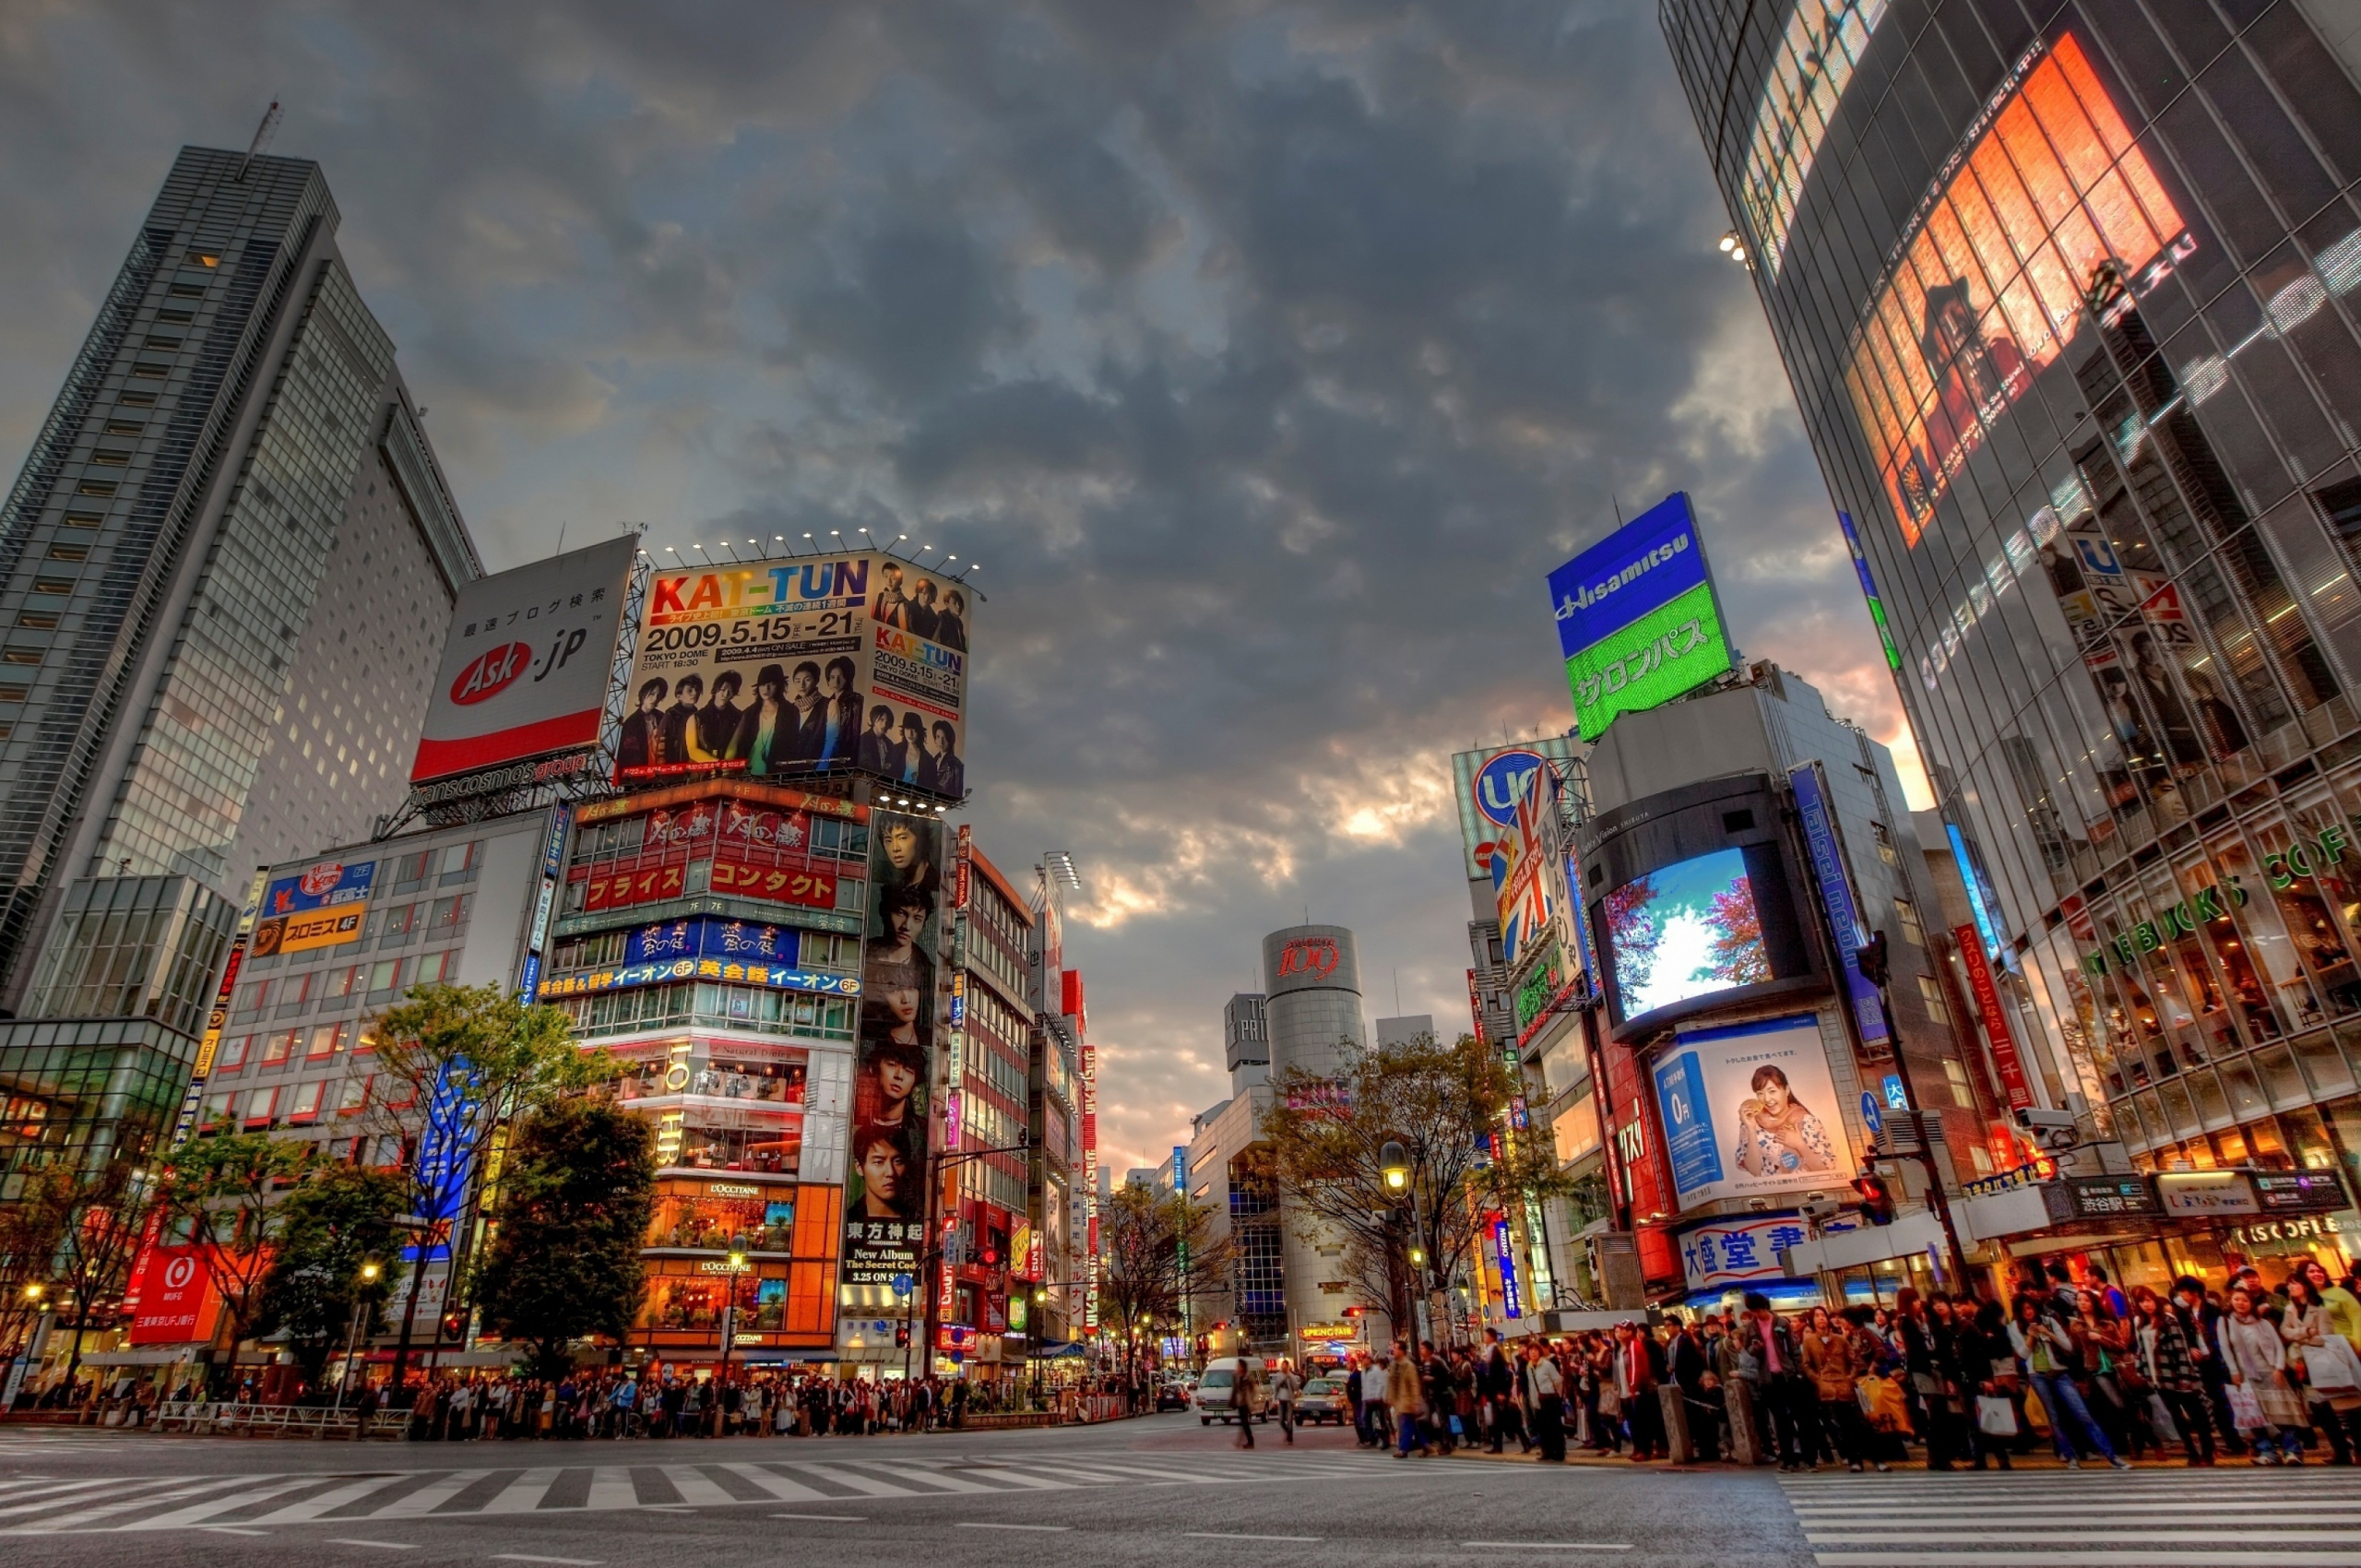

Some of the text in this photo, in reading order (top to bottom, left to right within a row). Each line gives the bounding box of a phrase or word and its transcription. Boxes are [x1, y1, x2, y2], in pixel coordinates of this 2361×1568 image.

[652, 559, 869, 614] KAT-TUN
[1554, 532, 1690, 621] Hisamitsu
[463, 588, 606, 637] 最速ブログ検索
[644, 616, 791, 653] 2009.5.15
[643, 649, 708, 662] TOKYO DOME
[875, 626, 962, 672] KAT-TUN
[641, 659, 698, 671] START 18:30
[874, 650, 933, 680] 2009.5.15
[874, 661, 897, 674] TOKYO
[898, 670, 919, 682] DOME
[1578, 618, 1709, 707] サロンパス
[409, 754, 587, 806] transcosmos group
[1619, 812, 1649, 828] SHIBUYA
[589, 863, 832, 903] プライス コンタクト
[1801, 793, 1859, 969] Taisei neon
[330, 885, 369, 904] 武富士
[689, 902, 699, 911] 7F
[710, 901, 722, 910] 7F
[285, 916, 357, 942] プロミス 4F
[1277, 944, 1339, 980] 109
[539, 963, 691, 996] 英会話&留学イーオン 6F
[698, 959, 839, 992] 英会話イーオン
[841, 980, 858, 992] 6F
[1249, 998, 1267, 1014] TH
[1961, 930, 2030, 1105] クスリのことなら 三千里
[1240, 1020, 1270, 1043] PRI
[200, 1038, 214, 1069] プロミス
[723, 1045, 792, 1060] Natural Dining
[710, 1183, 759, 1194] L'OCCITANE
[2082, 1196, 2125, 1212] 渋谷駅
[848, 1221, 923, 1241] 東方神起
[1498, 1227, 1509, 1257] MIZUHO
[854, 1248, 914, 1260] New Album
[1072, 1186, 1082, 1315] 洋装生地 マルナン
[1684, 1222, 1831, 1278] 大盛堂書
[846, 1259, 864, 1269] The
[865, 1260, 896, 1269] Secret
[853, 1272, 872, 1282] 3.25
[872, 1273, 887, 1282] ON
[162, 1291, 183, 1301] MUFG
[136, 1314, 196, 1327] 三菱東京UFJ銀行
[1302, 1326, 1353, 1337] SPRING FAIR
